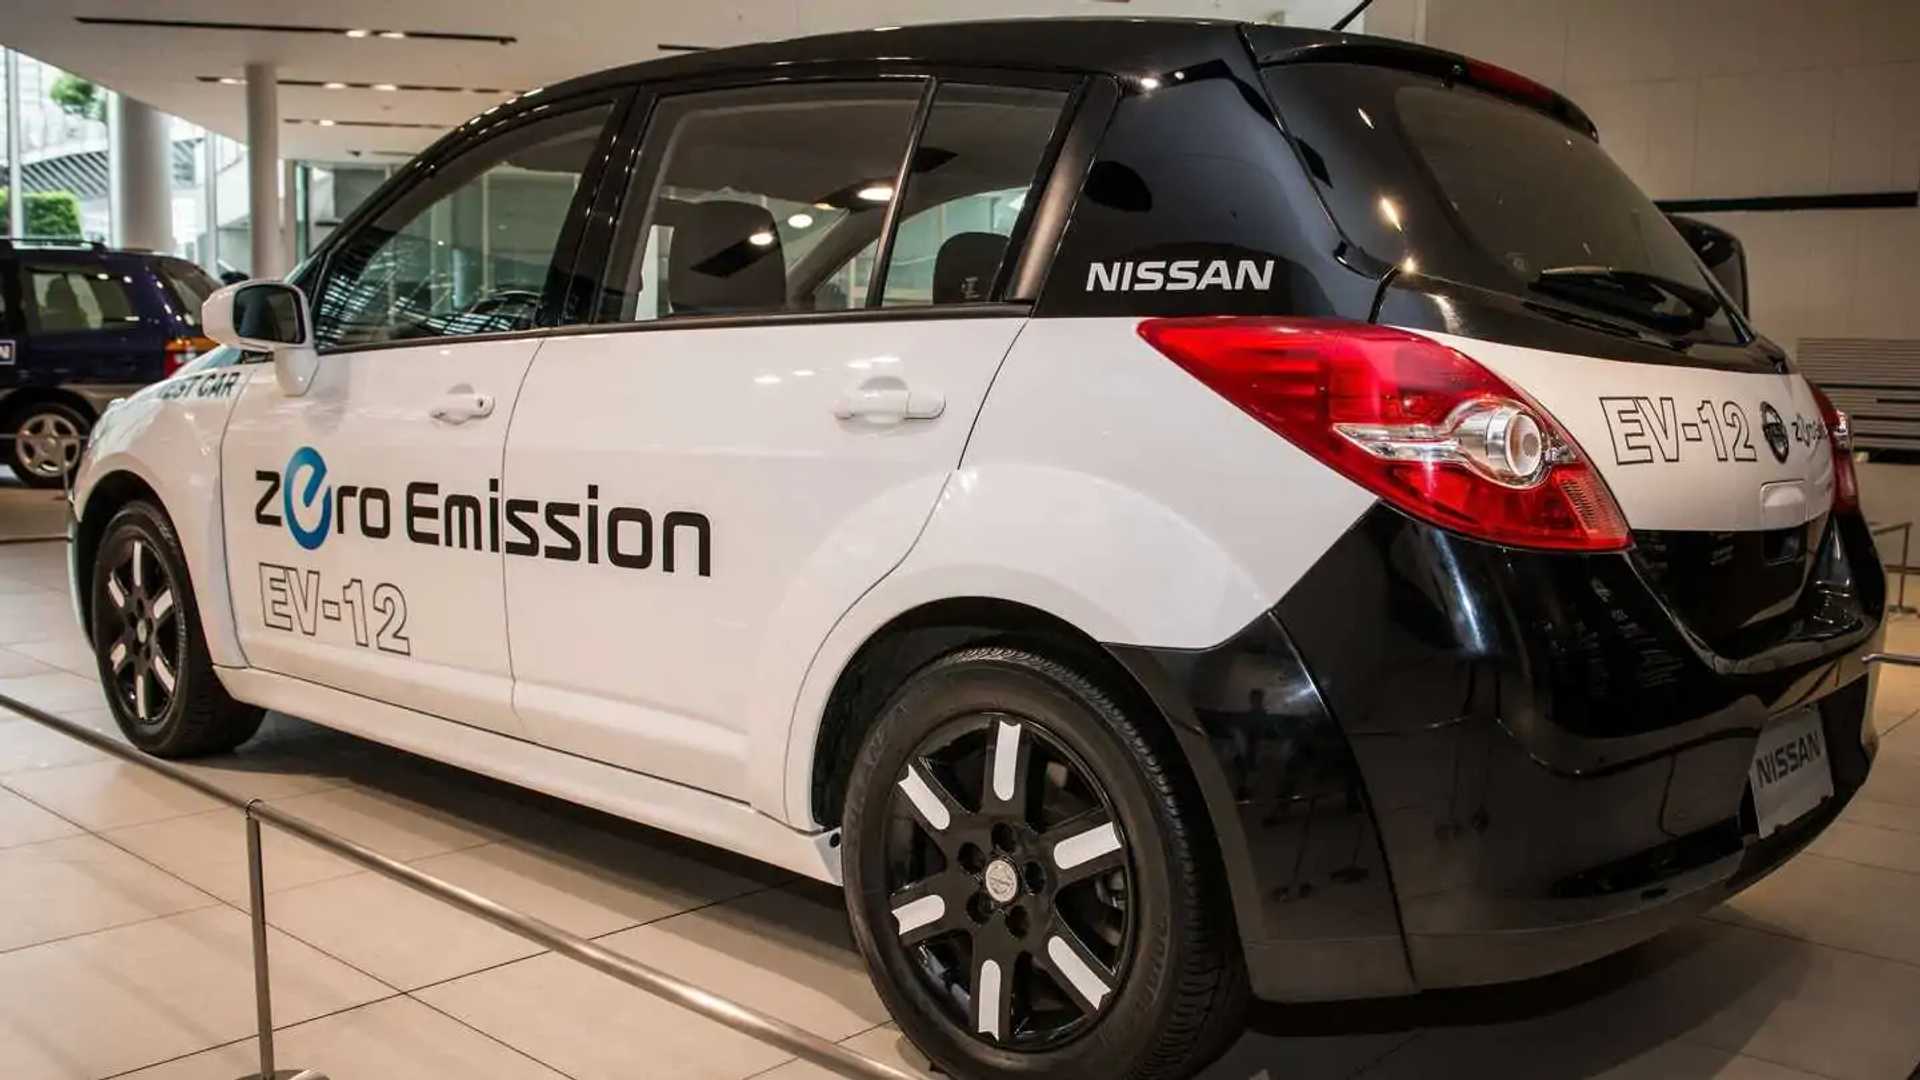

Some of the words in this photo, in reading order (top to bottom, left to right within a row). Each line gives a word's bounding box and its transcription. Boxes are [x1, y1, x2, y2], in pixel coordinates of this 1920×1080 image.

[1086, 260, 1275, 291] NISSAN
[197, 372, 241, 397] CAR
[1599, 397, 1757, 465] EV-12
[255, 446, 391, 550] zero
[406, 478, 711, 577] Emission
[258, 562, 411, 656] EV-12
[1755, 730, 1821, 789] NISSAN
